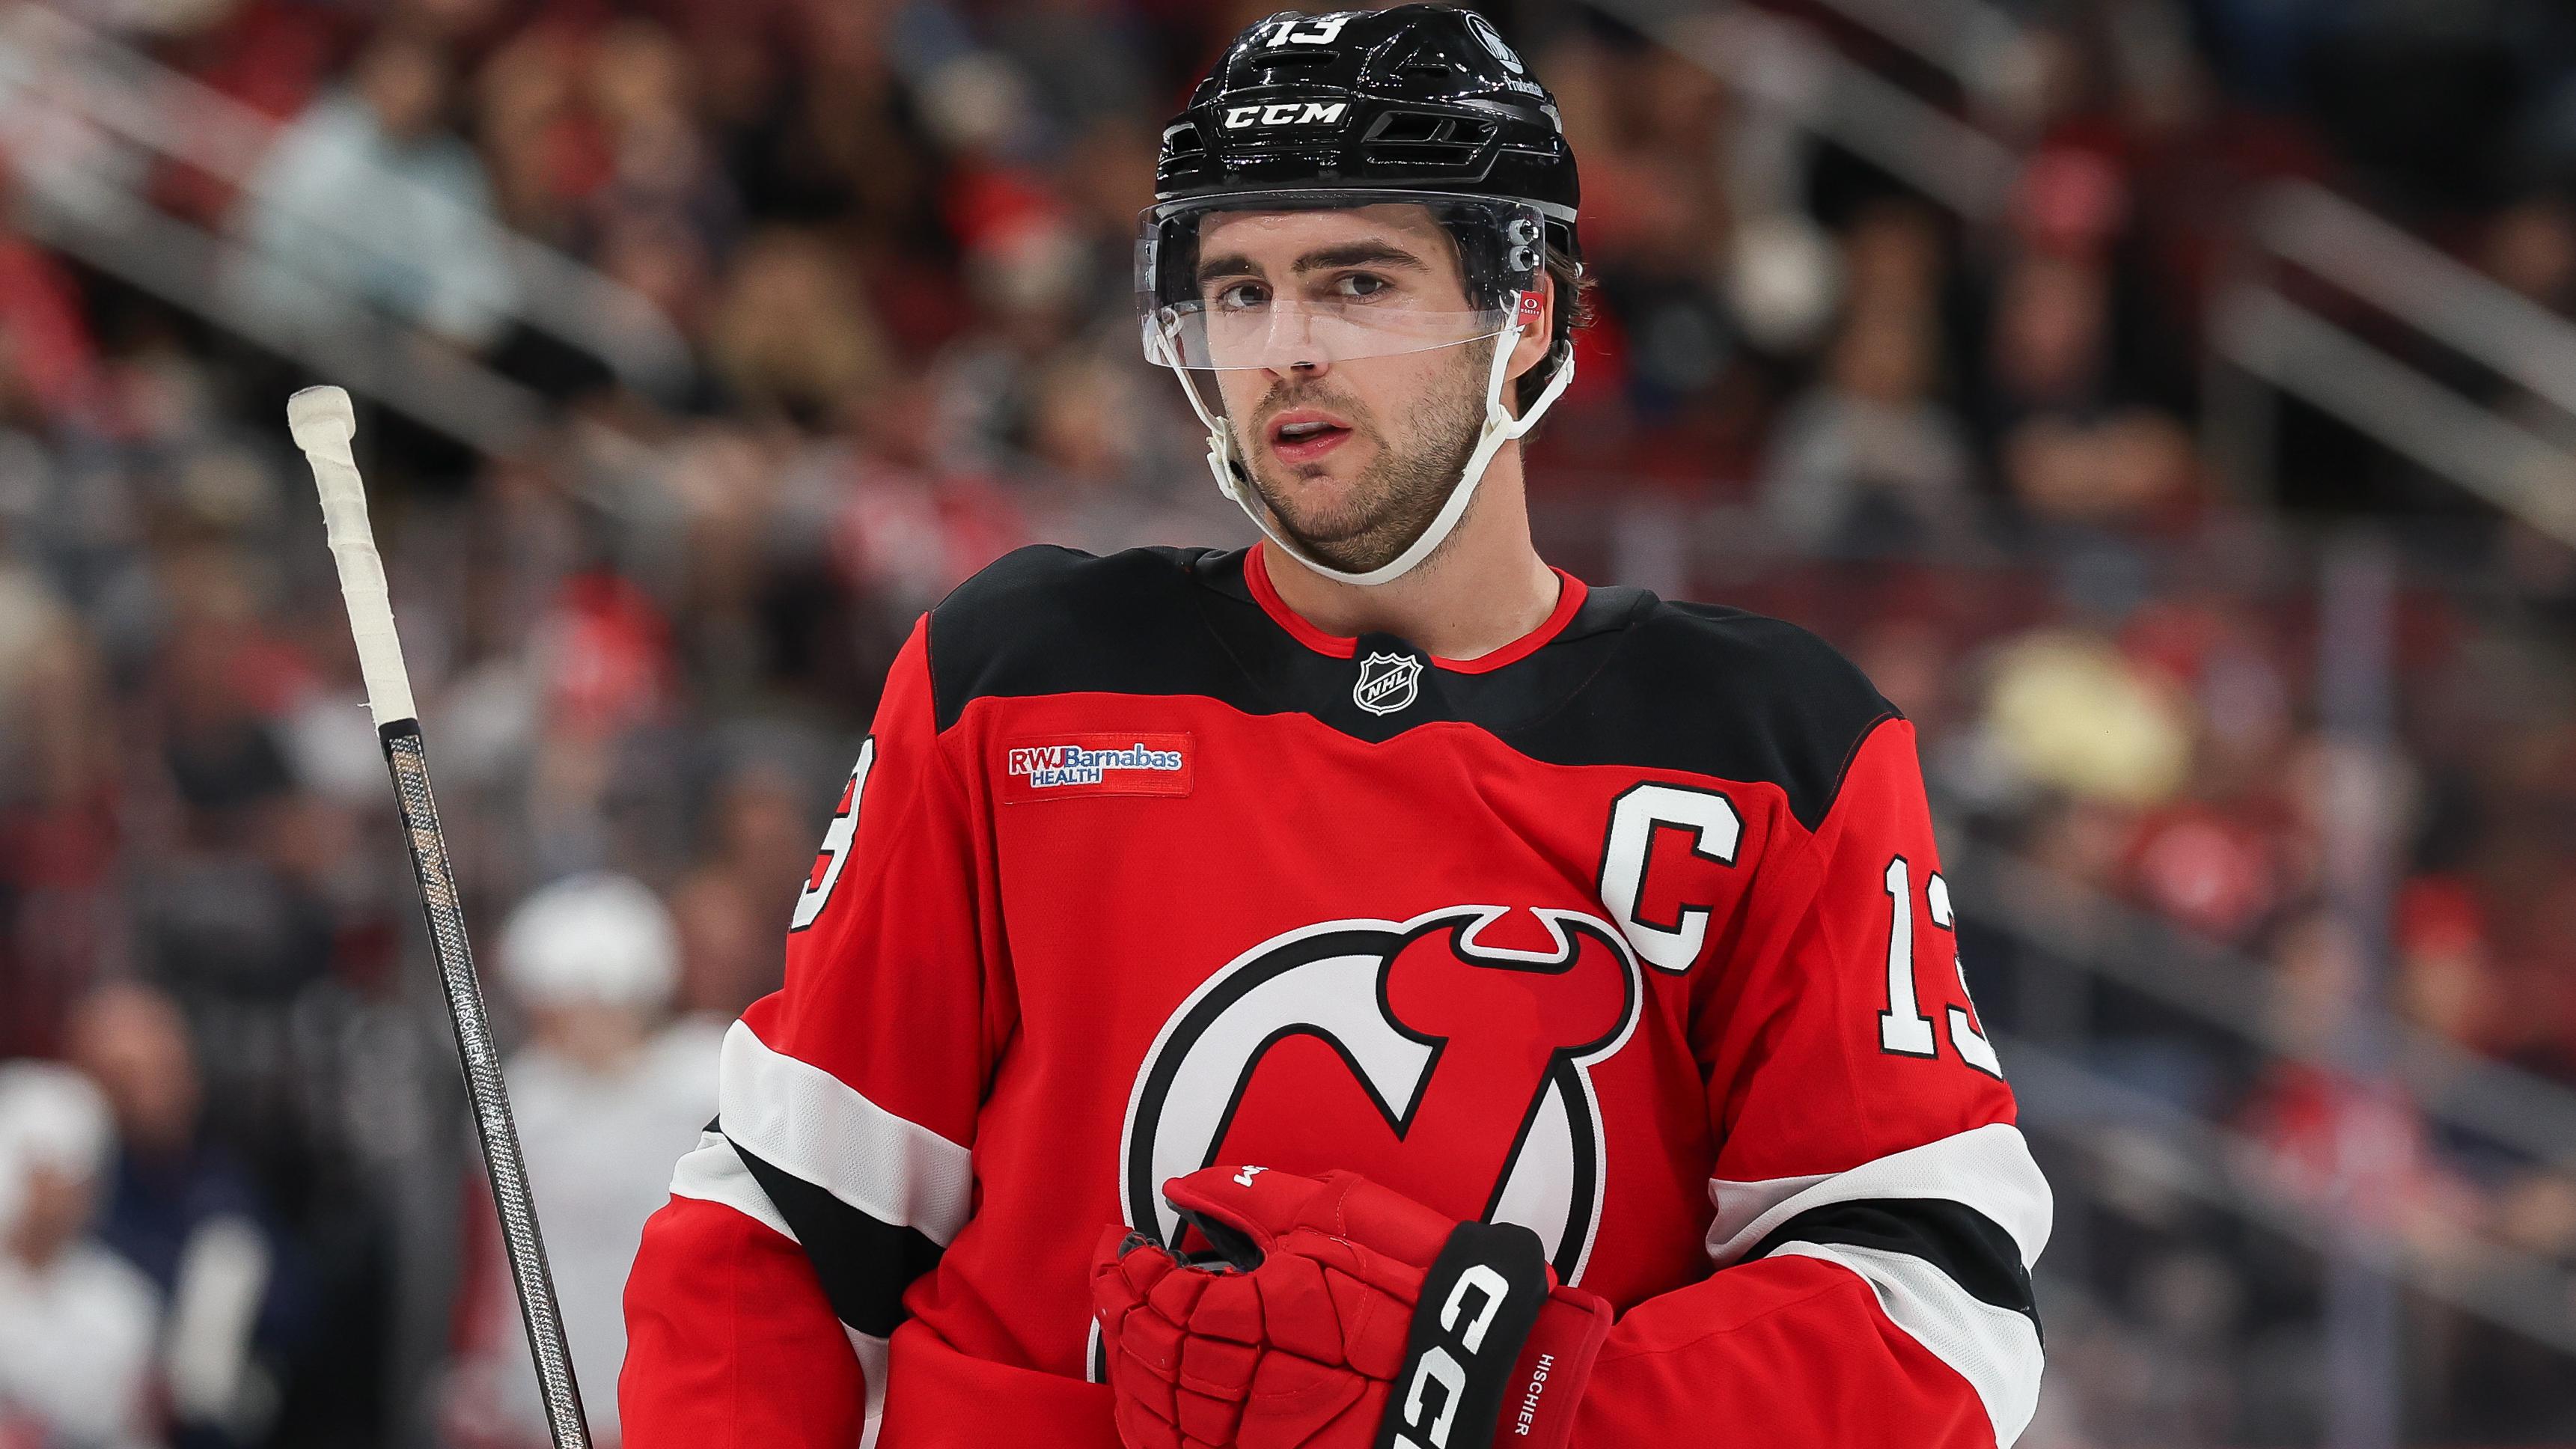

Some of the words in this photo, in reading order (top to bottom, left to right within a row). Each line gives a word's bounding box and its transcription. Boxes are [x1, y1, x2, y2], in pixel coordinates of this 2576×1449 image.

[1266, 18, 1351, 47] 13
[1224, 103, 1346, 129] CCM
[1367, 671, 1407, 701] NHL
[1010, 744, 1181, 774] RWJBarnabas
[1031, 768, 1100, 786] HEALTH
[1599, 782, 1742, 974] C
[457, 993, 487, 1066] HISCHIER
[1394, 1264, 1509, 1449] CC
[1515, 1353, 1554, 1436] HISCHIER
